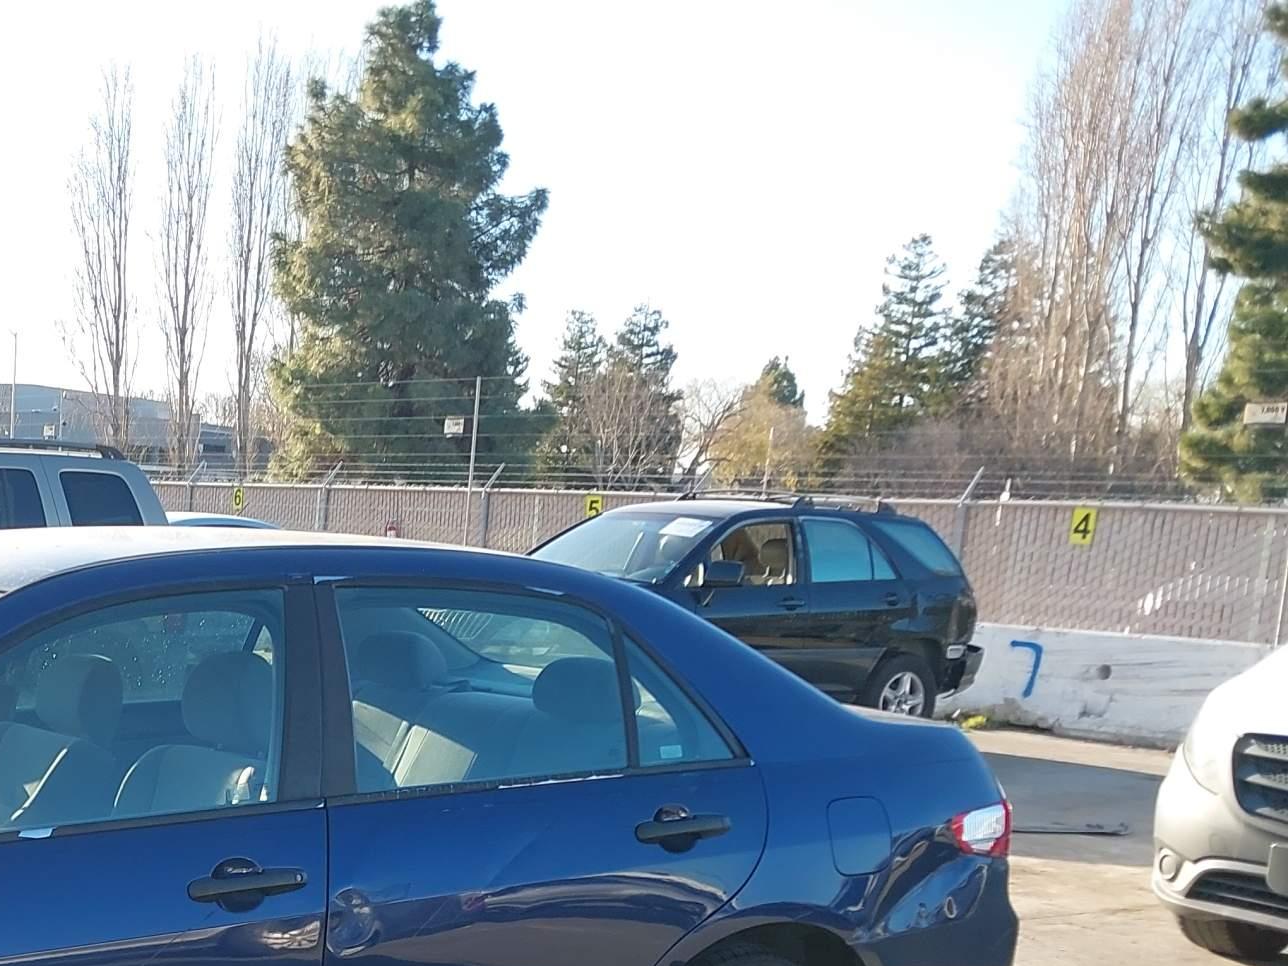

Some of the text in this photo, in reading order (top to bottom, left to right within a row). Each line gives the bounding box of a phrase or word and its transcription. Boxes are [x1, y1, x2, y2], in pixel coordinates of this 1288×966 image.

[234, 489, 242, 506] 6
[588, 499, 600, 516] 5
[1073, 512, 1091, 540] 4
[1009, 640, 1044, 698] 7
